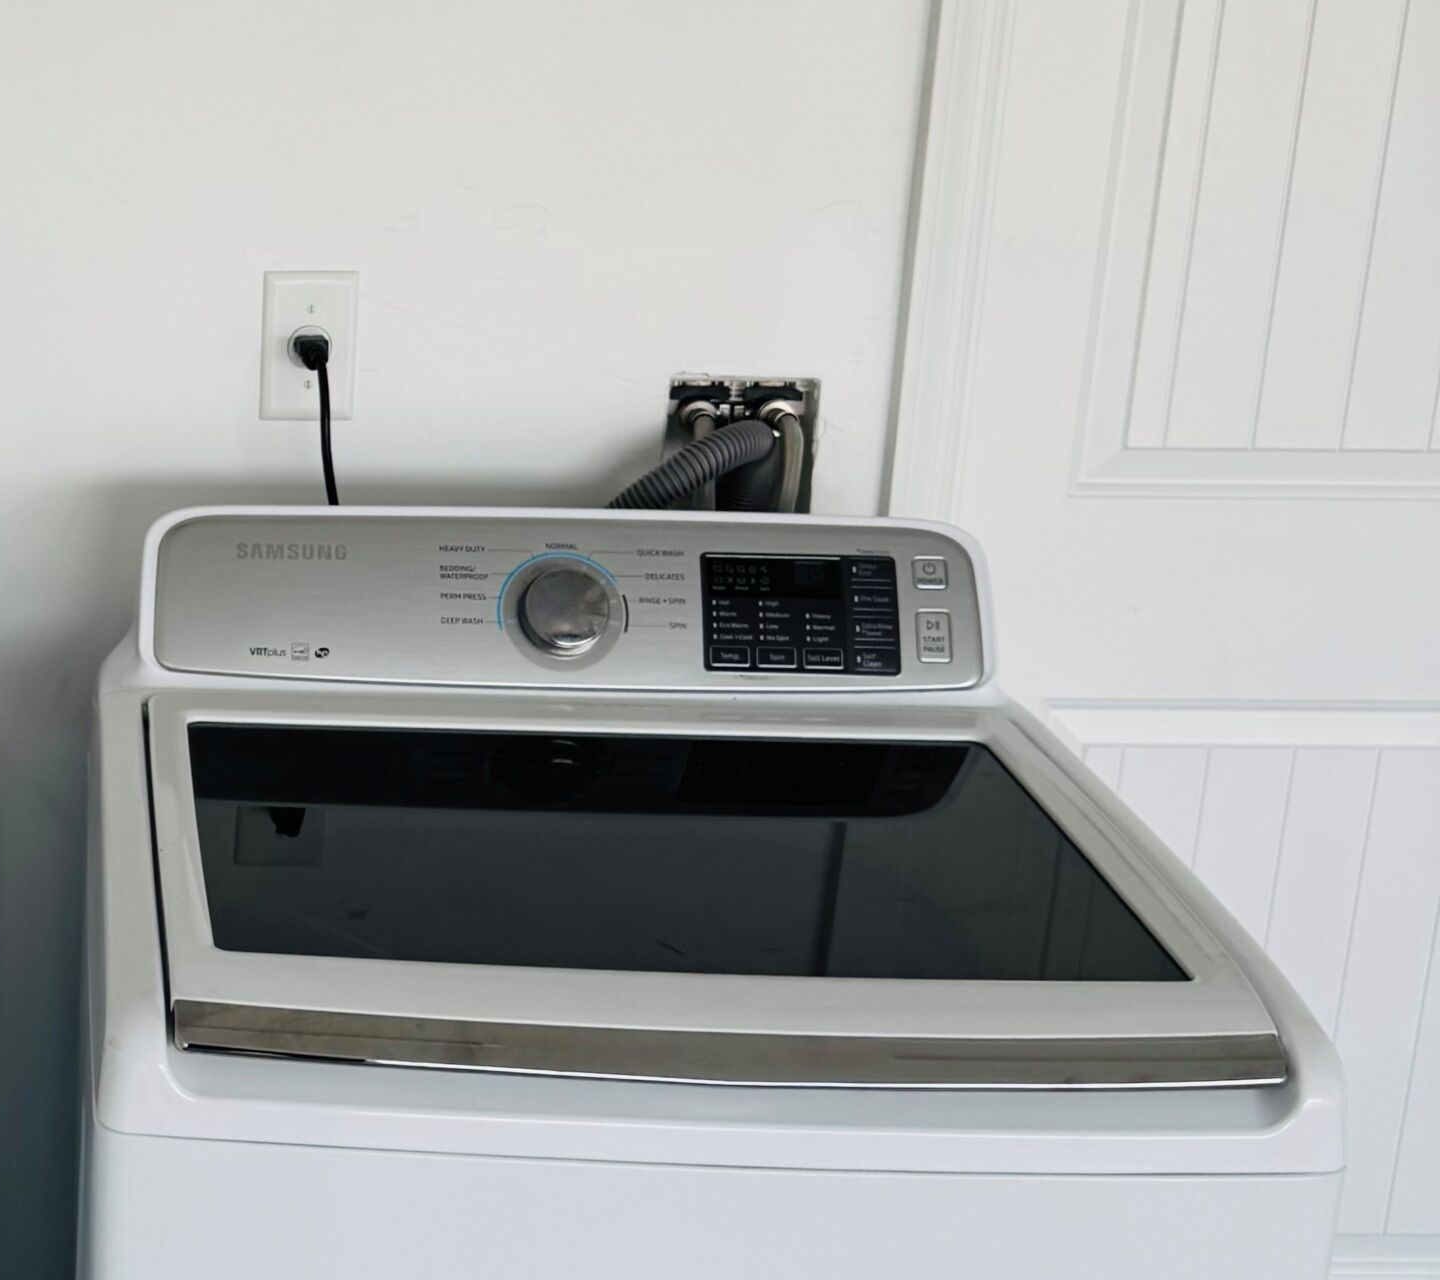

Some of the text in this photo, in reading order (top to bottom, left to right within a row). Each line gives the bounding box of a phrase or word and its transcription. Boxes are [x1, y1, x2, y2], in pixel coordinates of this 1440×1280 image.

[236, 542, 348, 561] SAMSUNG
[438, 545, 486, 553] HEAVY DUTY
[644, 573, 686, 581] DELICATES
[440, 592, 487, 601] PERM PRESS
[462, 617, 484, 625] WASH
[668, 622, 688, 630] SPIN
